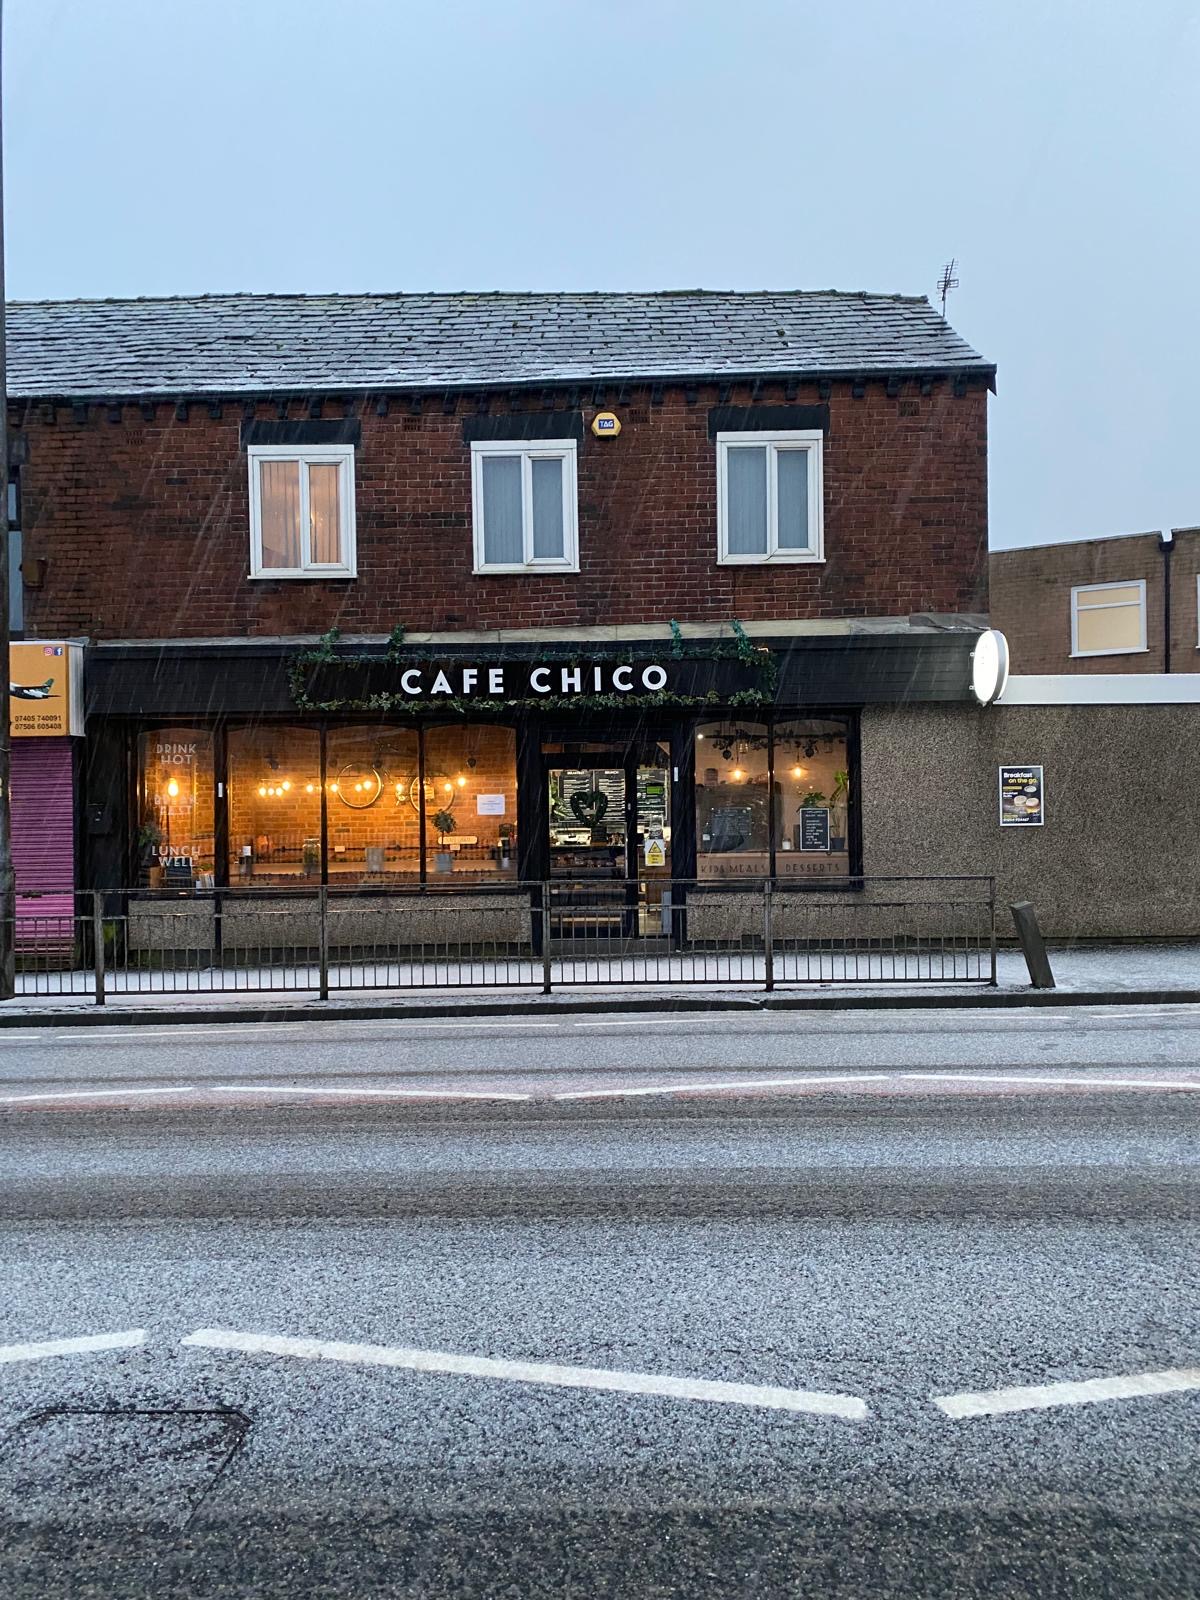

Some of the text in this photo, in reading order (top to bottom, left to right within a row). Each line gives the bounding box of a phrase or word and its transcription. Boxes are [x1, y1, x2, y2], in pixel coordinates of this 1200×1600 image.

[599, 420, 614, 428] TAG
[400, 665, 668, 695] CAFE CHICO
[156, 743, 197, 754] DRINK
[161, 754, 193, 765] HOT
[152, 846, 200, 856] LUNCH
[158, 856, 196, 867] WELL
[729, 864, 766, 873] MEALS
[785, 863, 840, 873] DESSERTS
